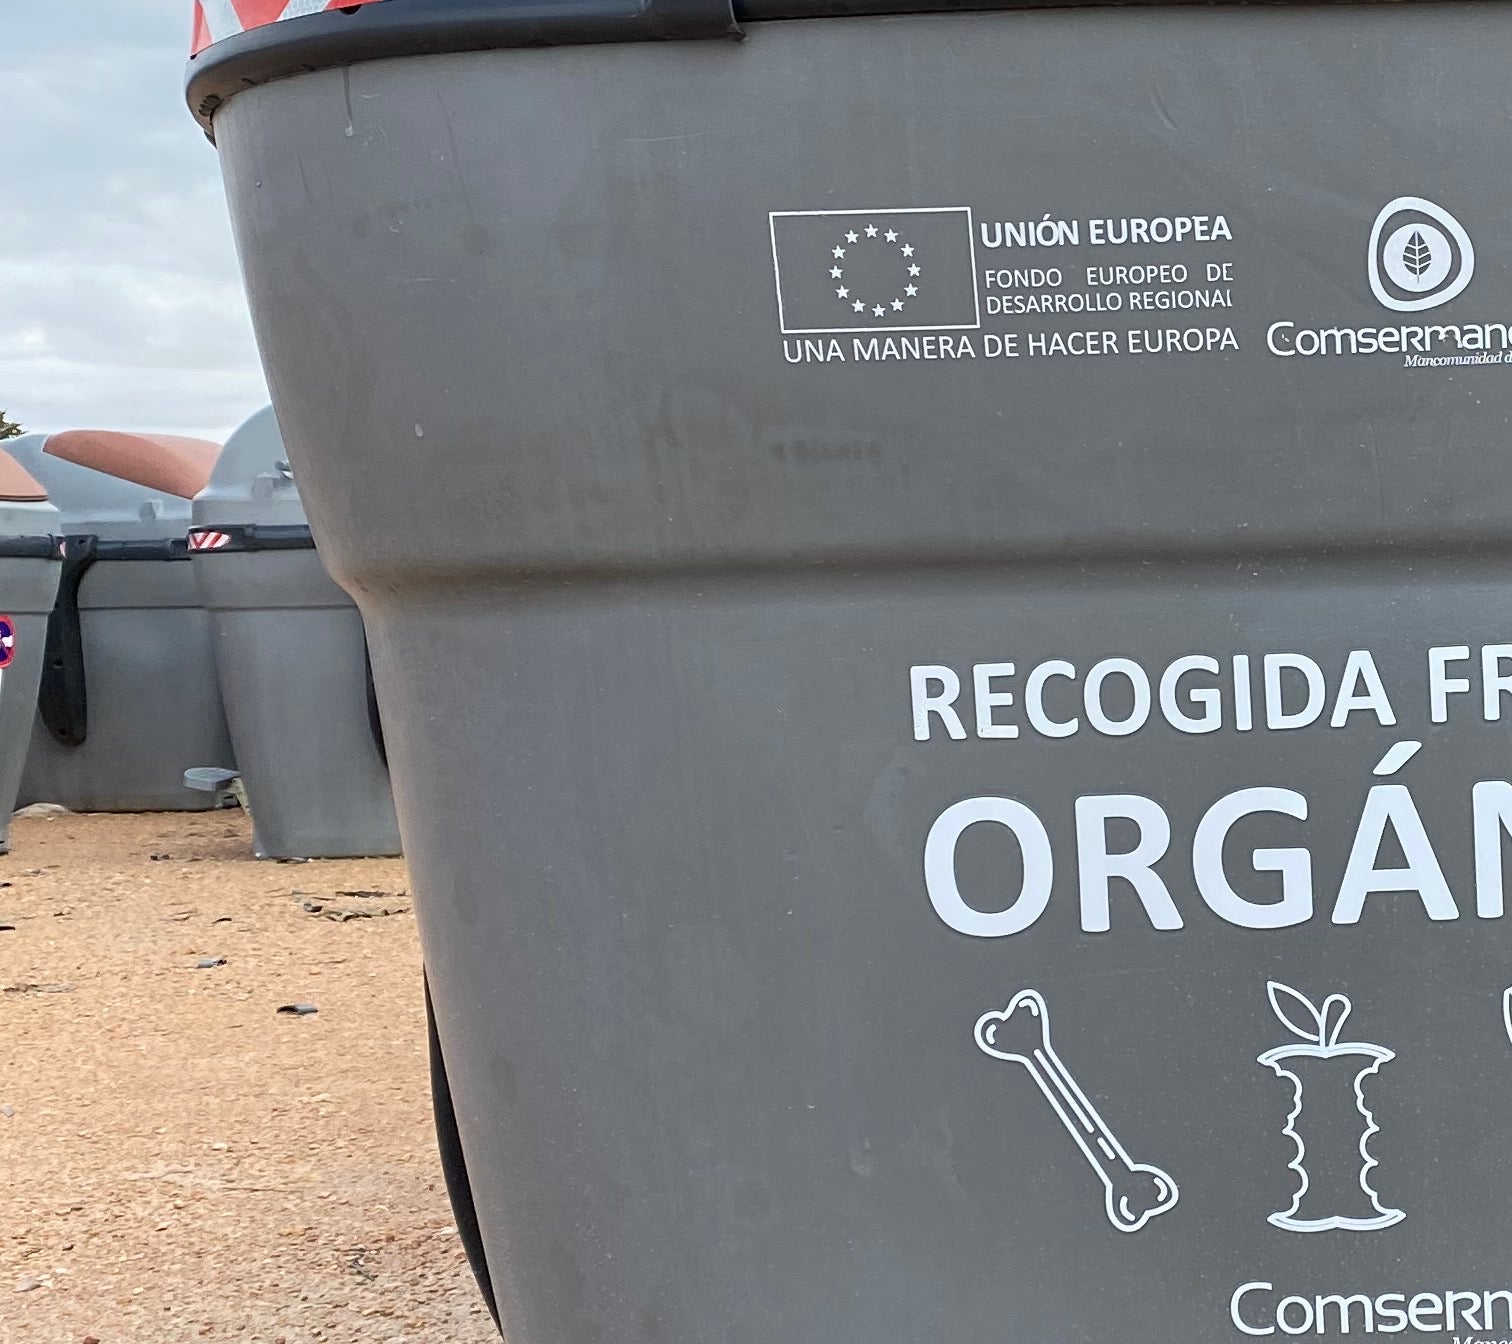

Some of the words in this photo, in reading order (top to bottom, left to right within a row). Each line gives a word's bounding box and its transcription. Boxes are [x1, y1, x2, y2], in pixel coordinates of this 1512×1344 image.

[980, 213, 1080, 248] UNIÓN
[1088, 215, 1233, 246] EUROPEA
[985, 268, 1063, 290] FONDO
[1086, 264, 1189, 287] EUROPEO
[1206, 262, 1234, 283] DE
[986, 291, 1123, 316] DESARROLLO
[783, 338, 846, 364] UNA
[852, 334, 976, 362] MANERA
[983, 333, 1020, 358] DE
[1028, 331, 1119, 357] HACER
[1127, 327, 1240, 354] EUROPA
[1403, 350, 1503, 368] Mancomunidad
[909, 649, 1398, 742] RECOGIDA
